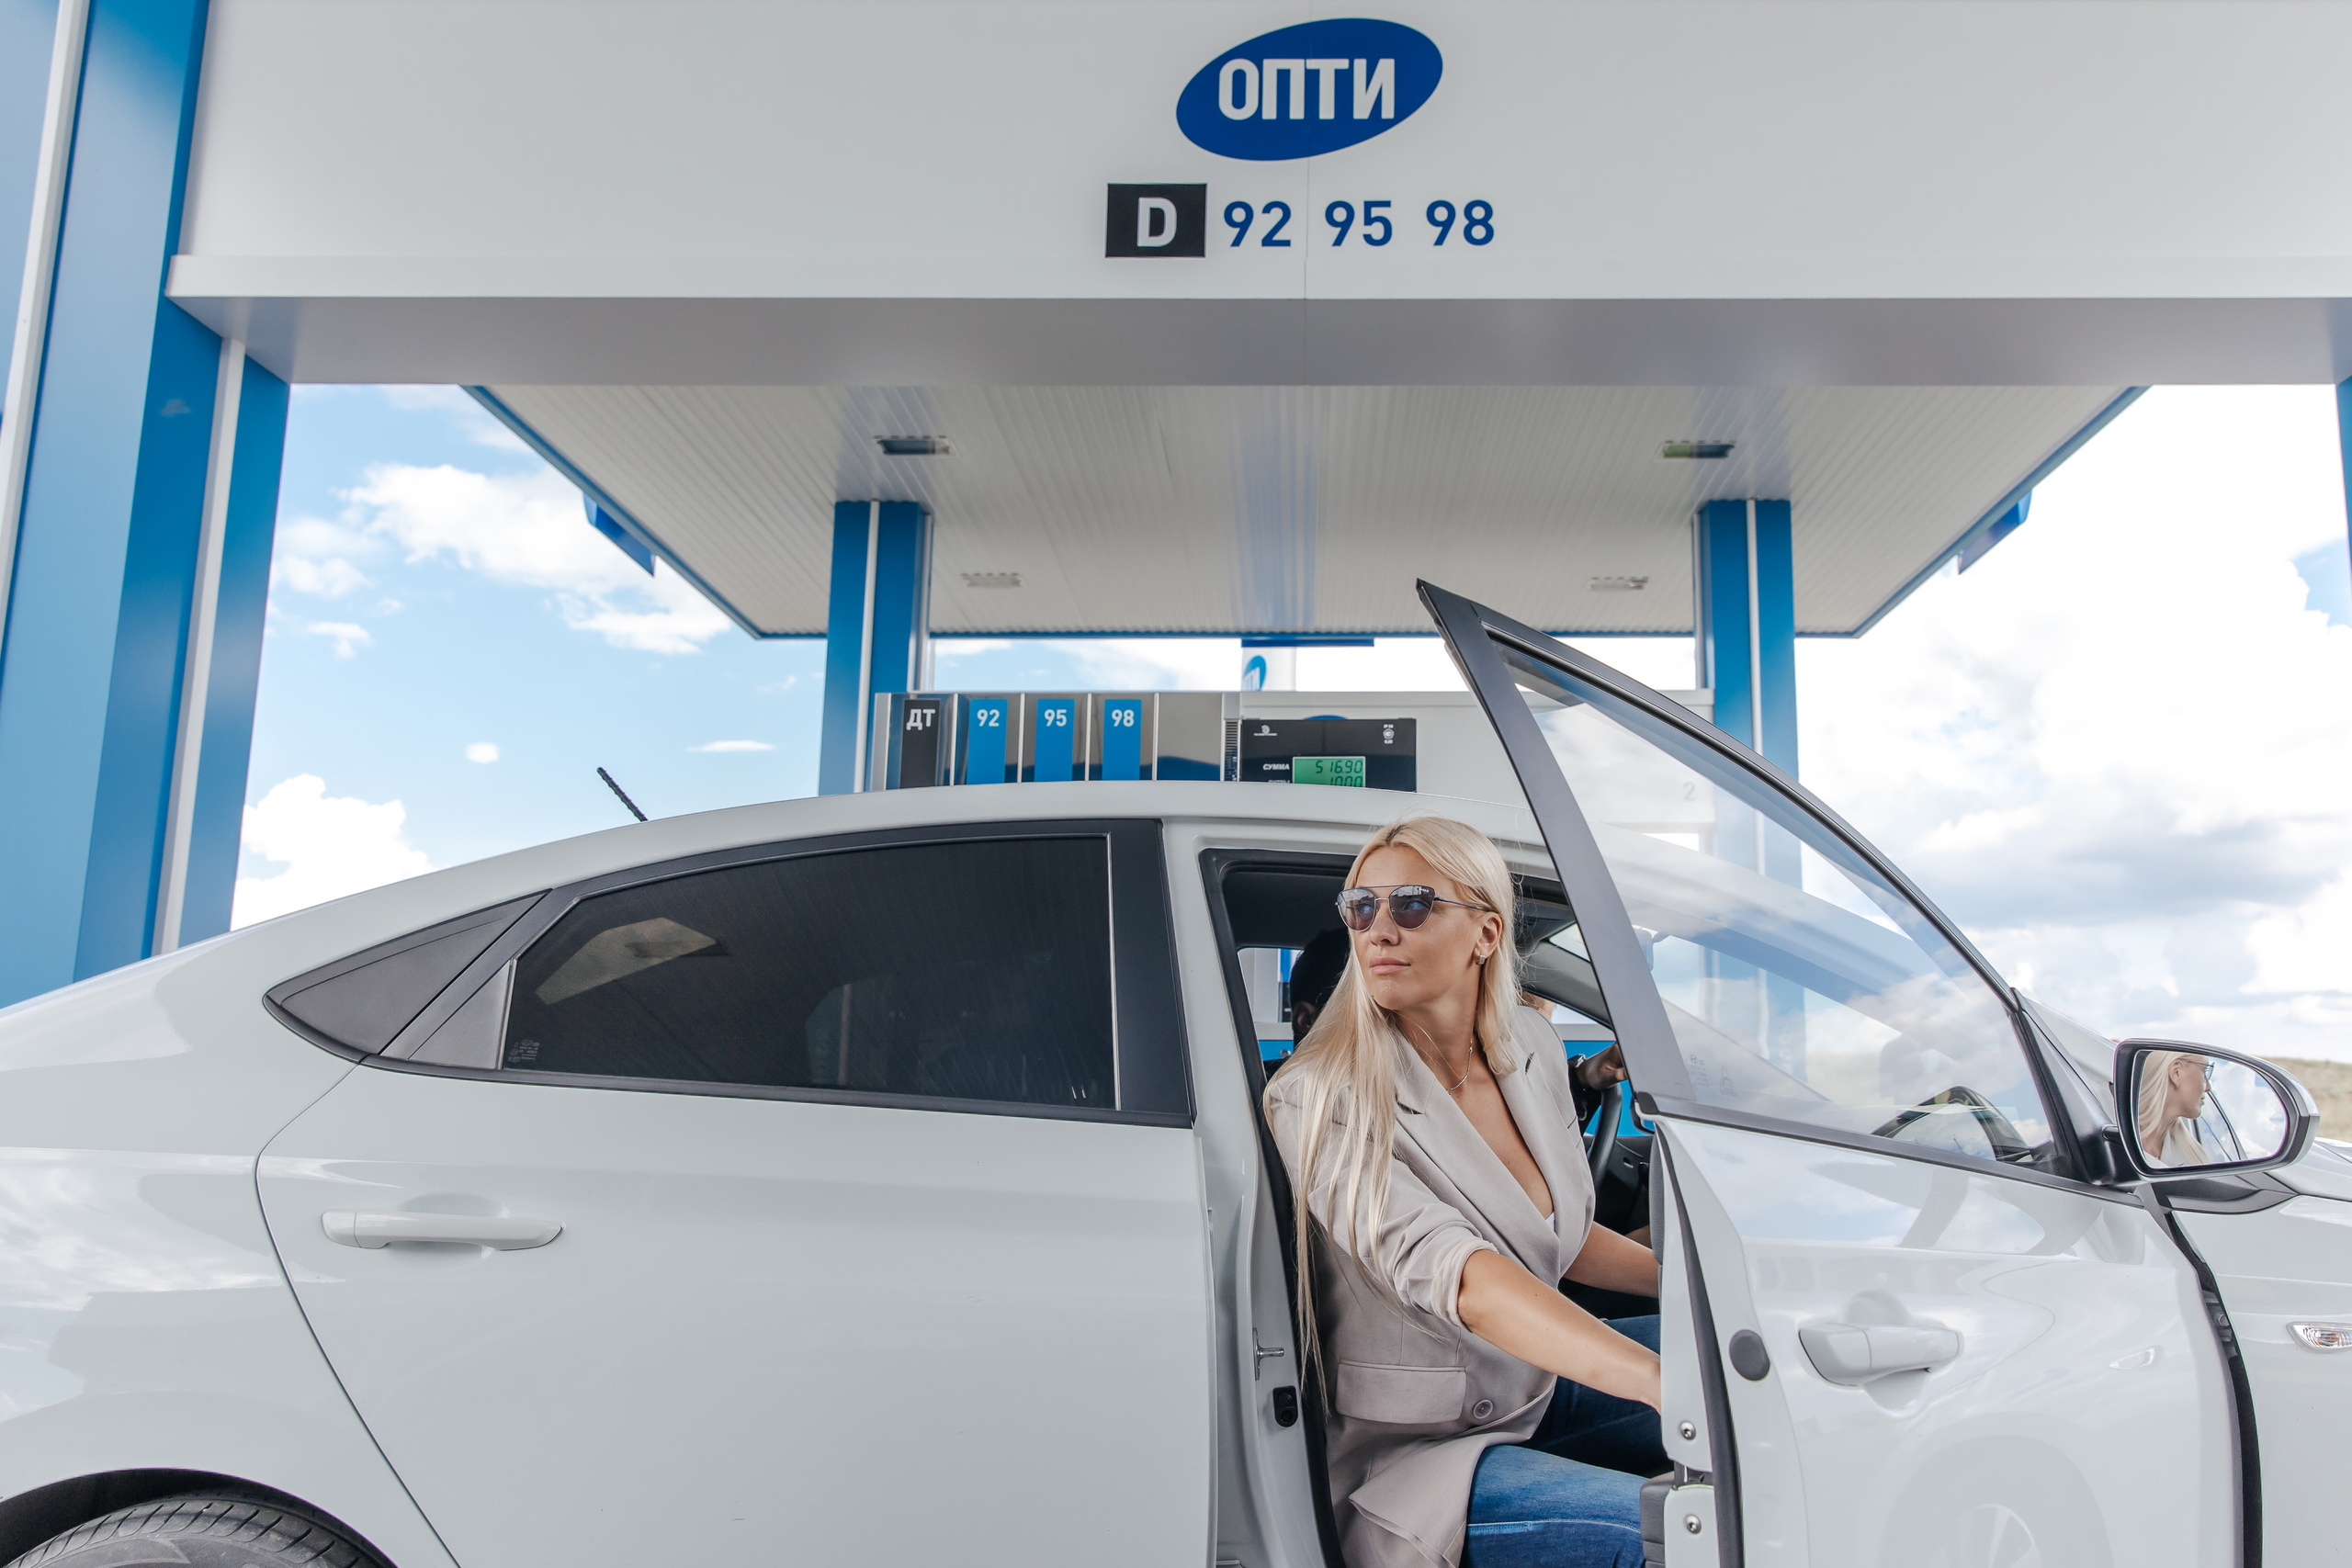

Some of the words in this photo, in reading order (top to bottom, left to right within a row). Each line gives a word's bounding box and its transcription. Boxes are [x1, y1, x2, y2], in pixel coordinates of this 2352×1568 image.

[1217, 58, 1396, 121] ОПТИ
[1136, 197, 1178, 248] D
[1223, 200, 1292, 248] 92
[1324, 199, 1393, 247] 95
[1426, 199, 1495, 247] 98
[906, 708, 936, 731] ДТ
[977, 708, 1001, 728] 92
[1044, 708, 1068, 728] 95
[1111, 708, 1135, 728] 98
[1682, 781, 1697, 802] 2
